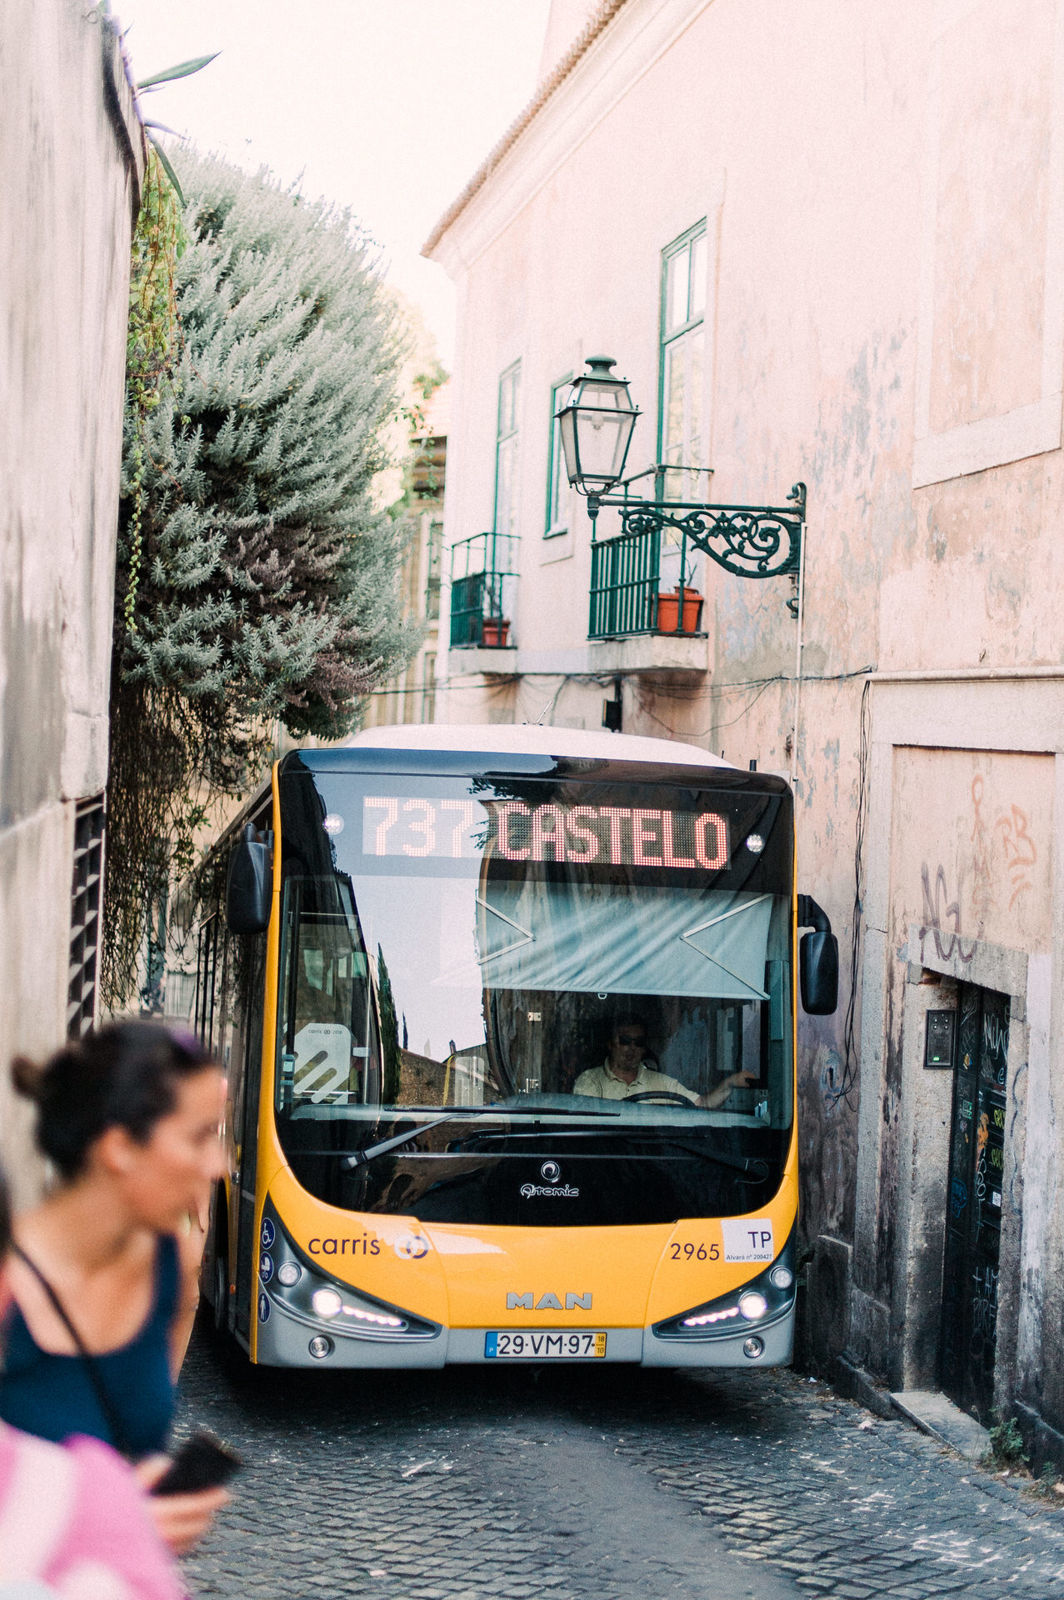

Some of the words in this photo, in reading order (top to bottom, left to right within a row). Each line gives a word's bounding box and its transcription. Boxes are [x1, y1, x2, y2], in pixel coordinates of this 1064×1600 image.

[363, 797, 475, 858] 737
[498, 802, 729, 870] CASTELO
[308, 1232, 381, 1256] carris
[747, 1231, 772, 1249] TP
[670, 1243, 720, 1261] 2965
[506, 1292, 593, 1310] MAN
